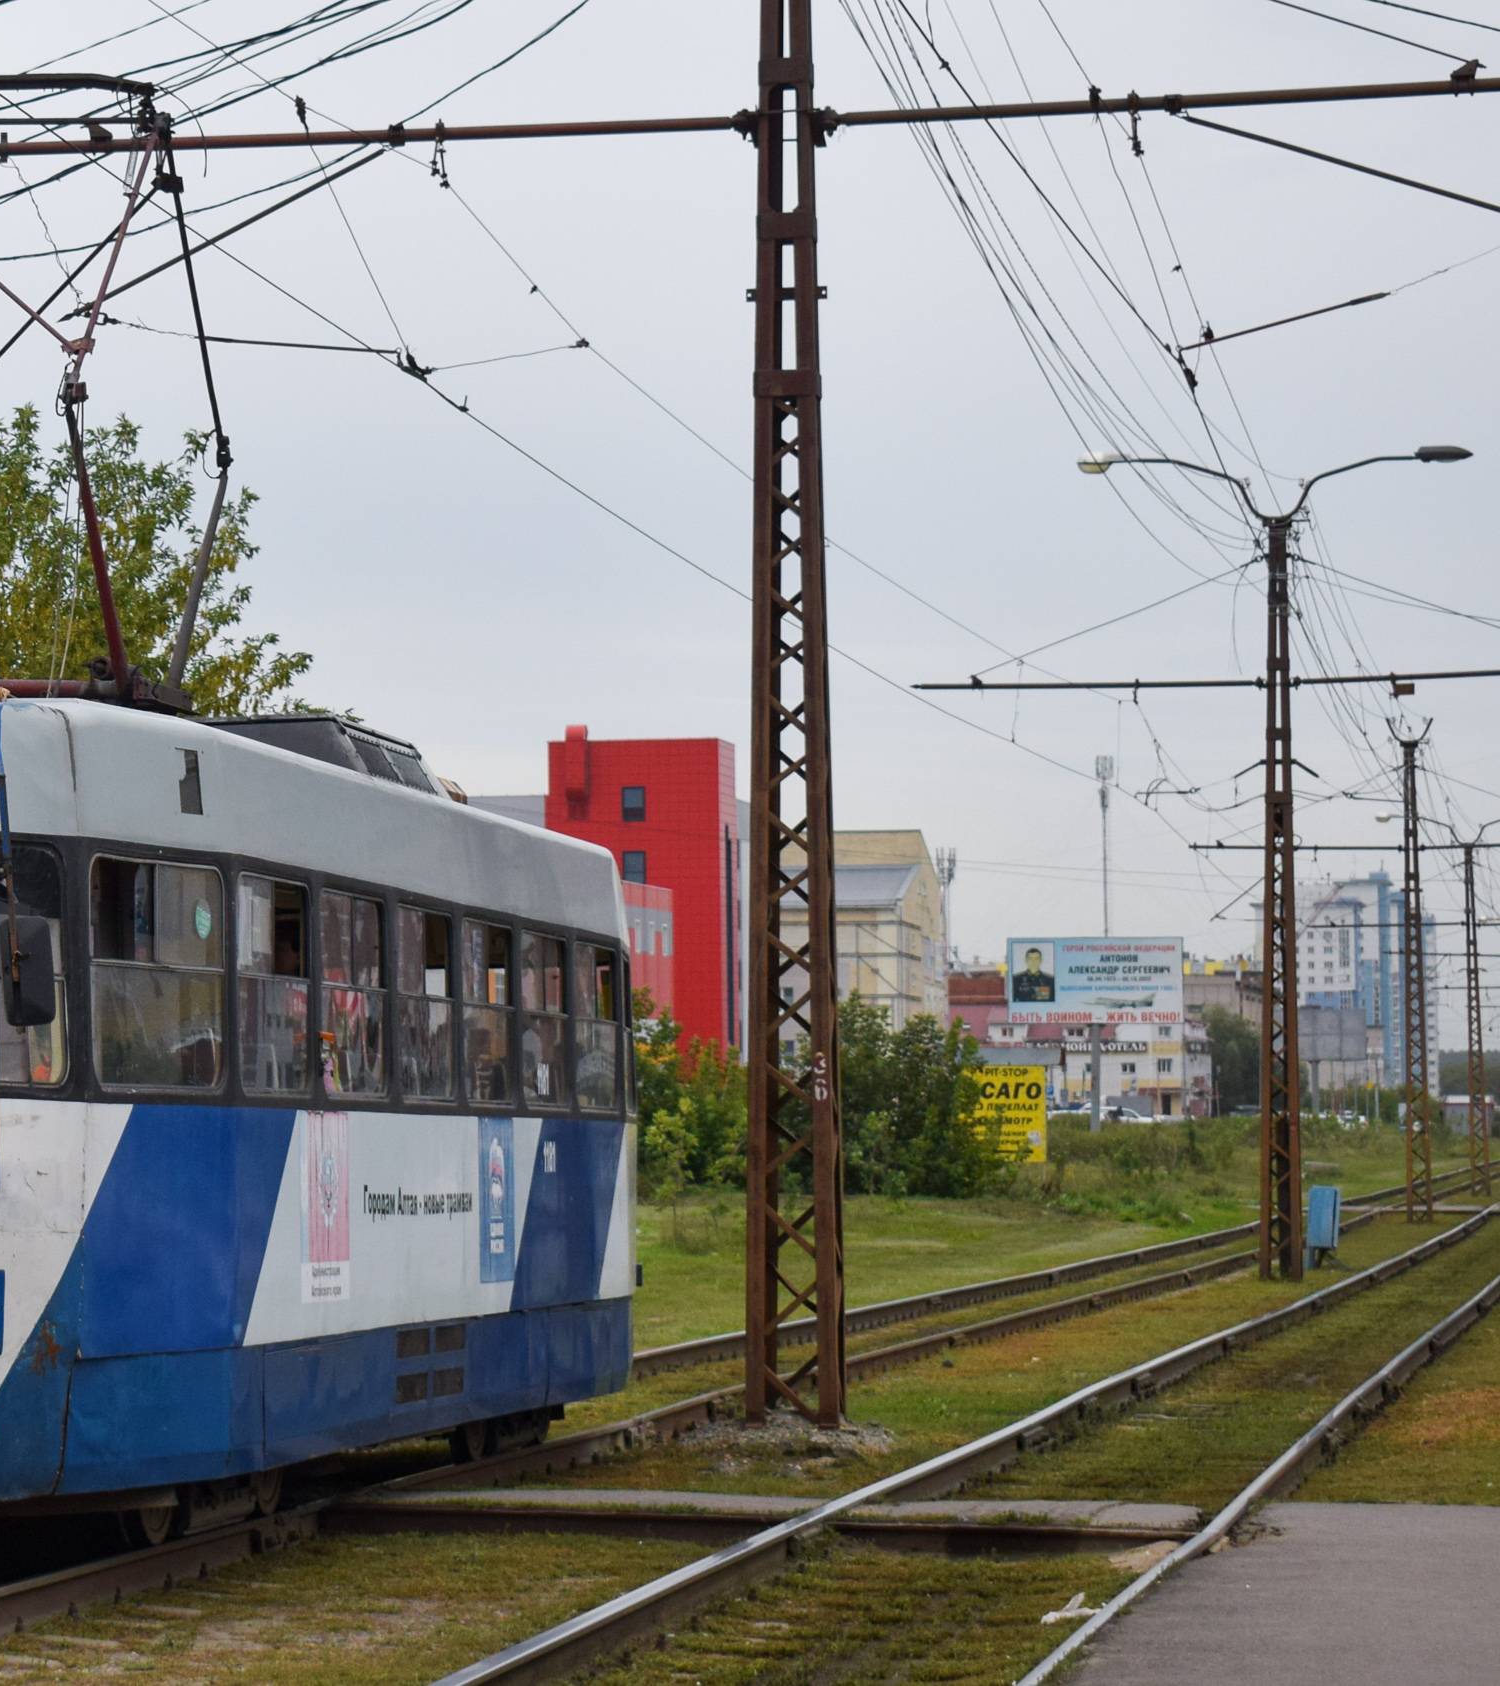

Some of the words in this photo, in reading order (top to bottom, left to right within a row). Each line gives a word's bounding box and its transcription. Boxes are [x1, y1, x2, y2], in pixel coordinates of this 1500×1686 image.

[1099, 954, 1139, 963] АНТОНОВ
[1068, 965, 1119, 974] АЛЕКСАНДР
[1122, 965, 1171, 974] СЕРГЕЕВИЧ
[1011, 1012, 1042, 1023] БЫТЬ
[1046, 1012, 1092, 1022] ВОИНОМ
[1106, 1012, 1138, 1022] ЖИТЬ
[1141, 1011, 1181, 1022] ВЕЧНО!
[981, 1082, 1042, 1099] САГО
[543, 1141, 557, 1173] 1181
[363, 1184, 396, 1224] Городам
[397, 1185, 418, 1216] Алтая
[423, 1193, 445, 1215] новые
